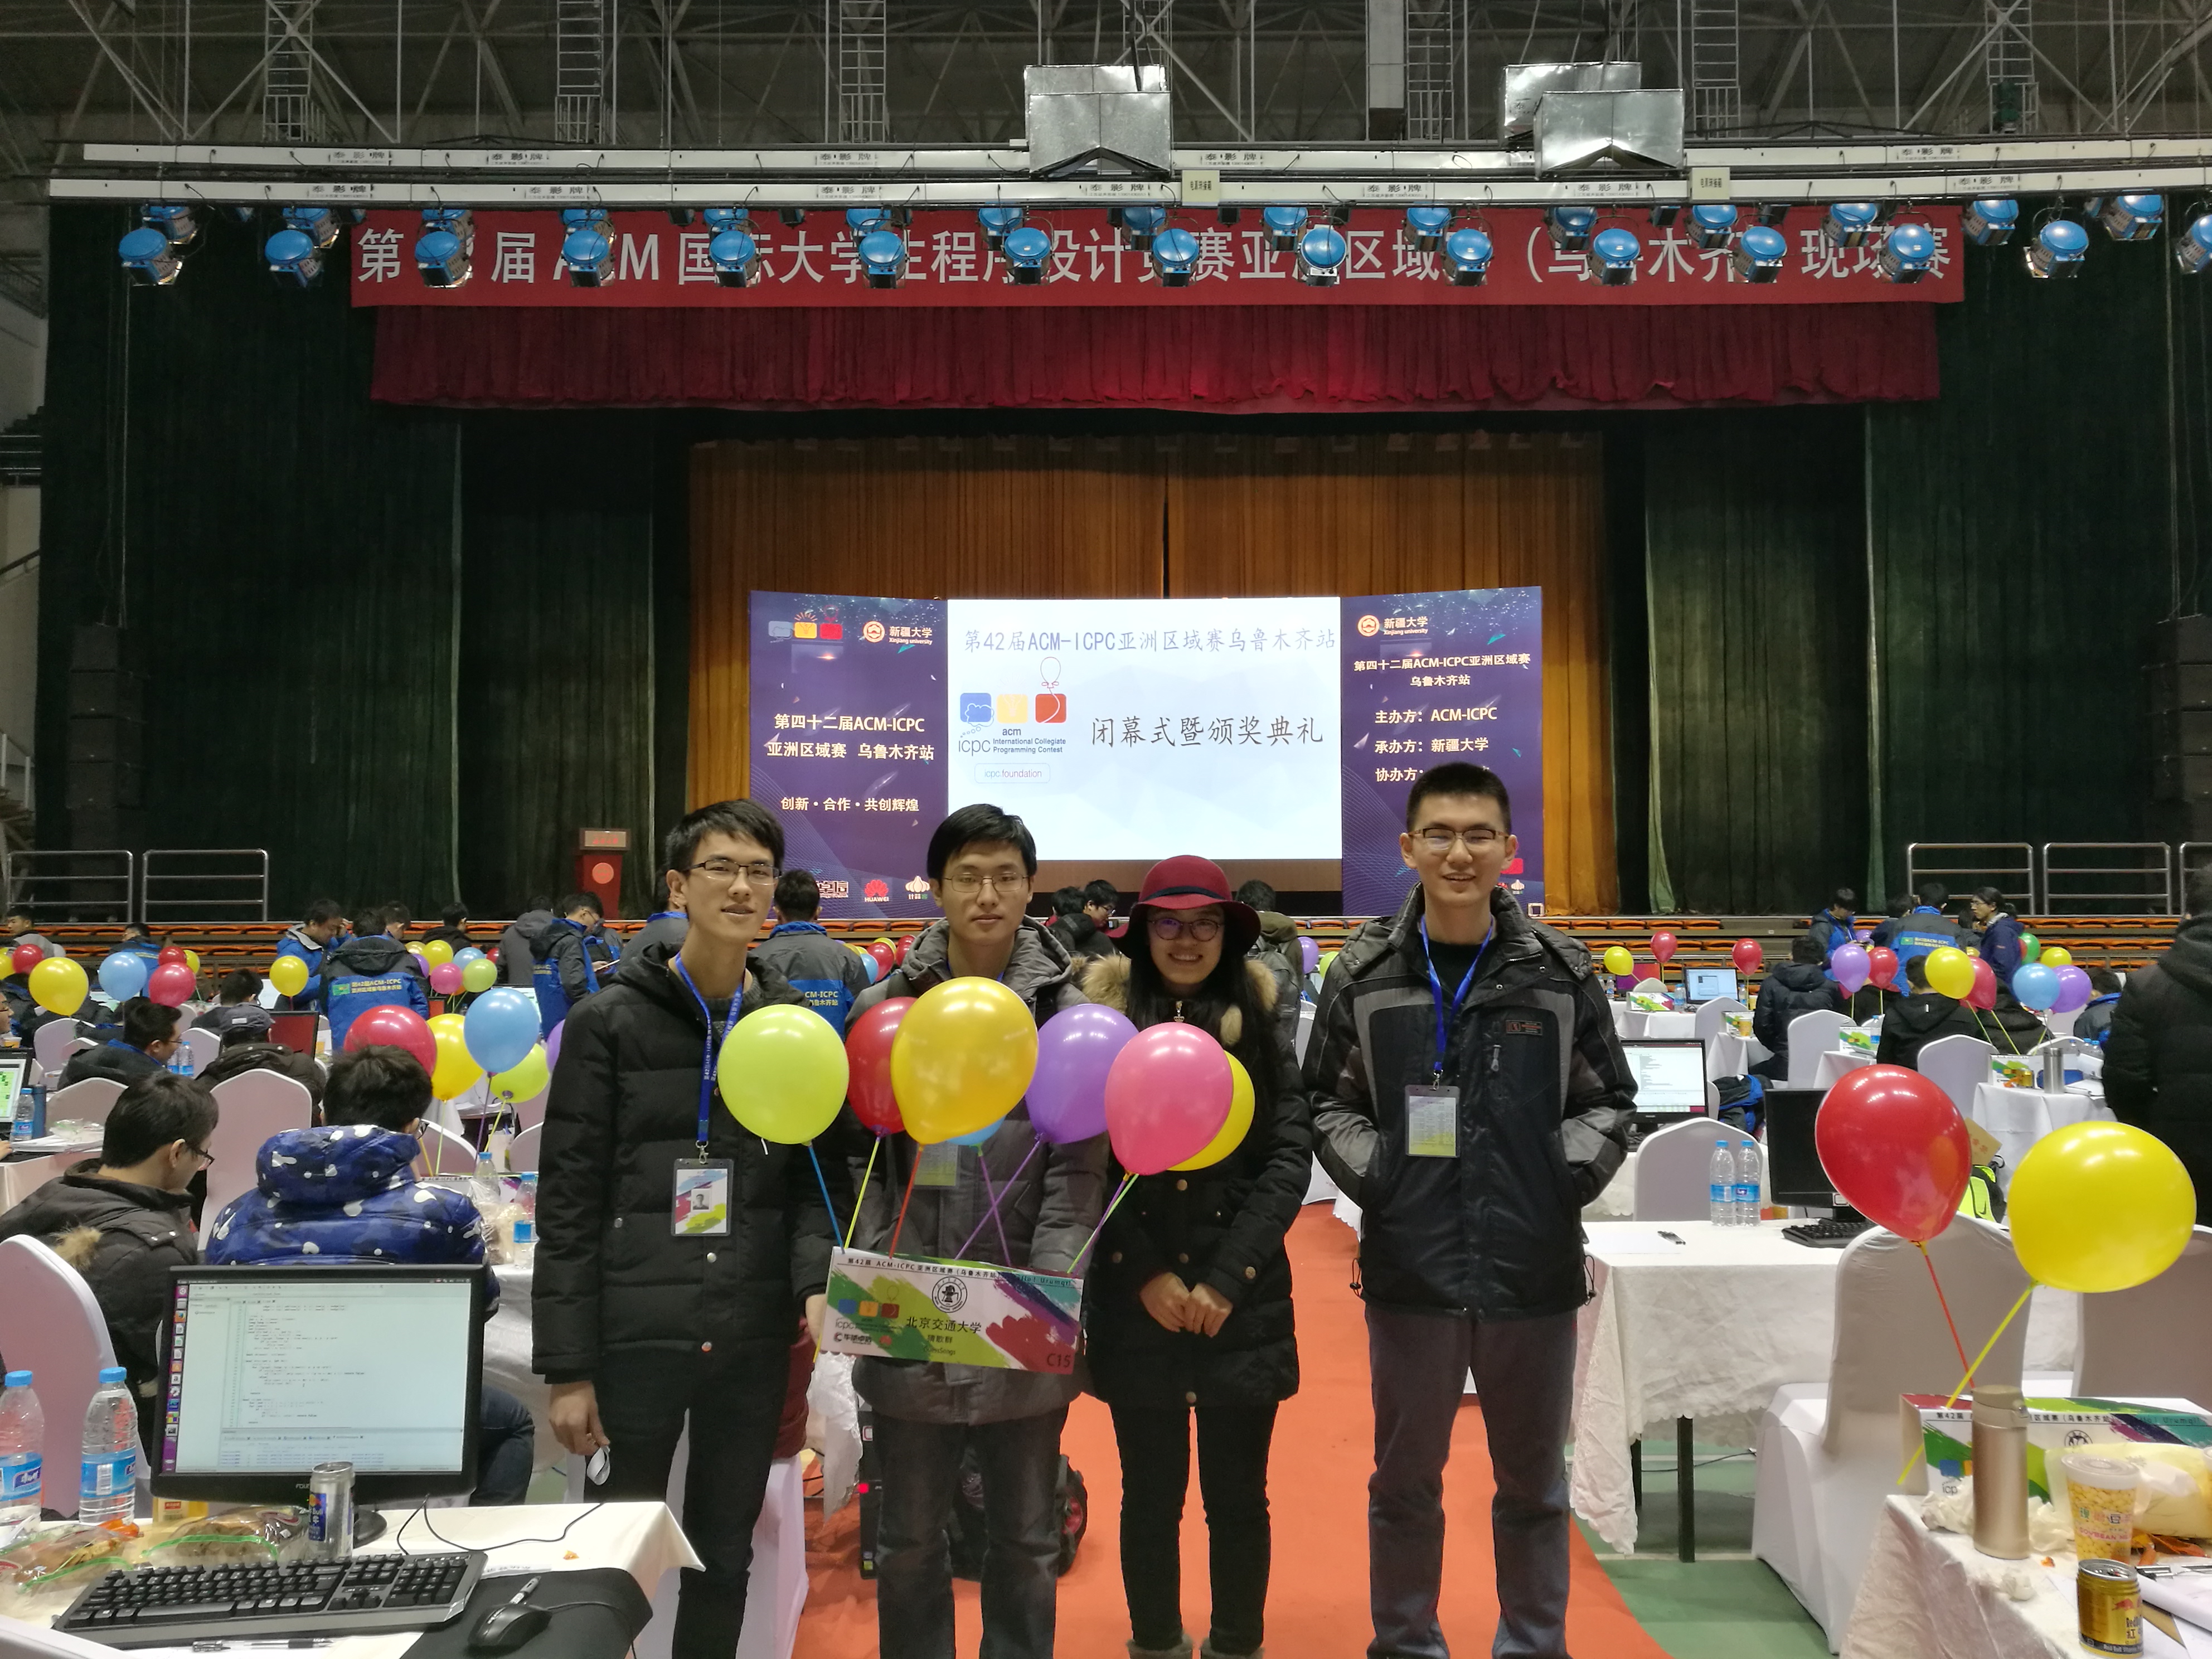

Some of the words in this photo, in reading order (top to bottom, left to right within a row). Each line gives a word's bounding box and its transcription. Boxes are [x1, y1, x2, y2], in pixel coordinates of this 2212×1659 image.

[1384, 617, 1428, 629] 新疆大学
[889, 626, 932, 638] 新疆大学
[964, 628, 1335, 653] 第42届ACM-ICPC亚洲区域赛乌鲁木齐站
[1354, 653, 1531, 672] 第四十二届ACM-ICPC亚洲区域赛
[1410, 675, 1471, 687] 乌鲁木齐站
[774, 714, 925, 732] 第四十二届ACM-ICPC
[1002, 727, 1021, 736] acm
[1092, 715, 1323, 747] 闭幕式暨颁奖典礼
[767, 742, 847, 758] 亚洲区域赛
[858, 743, 934, 760] 乌鲁木齐站
[958, 739, 991, 756] icpc
[984, 769, 1042, 779] icpc.foundation
[906, 1316, 982, 1334] 北京交通大学
[1942, 1483, 1958, 1496] icp
